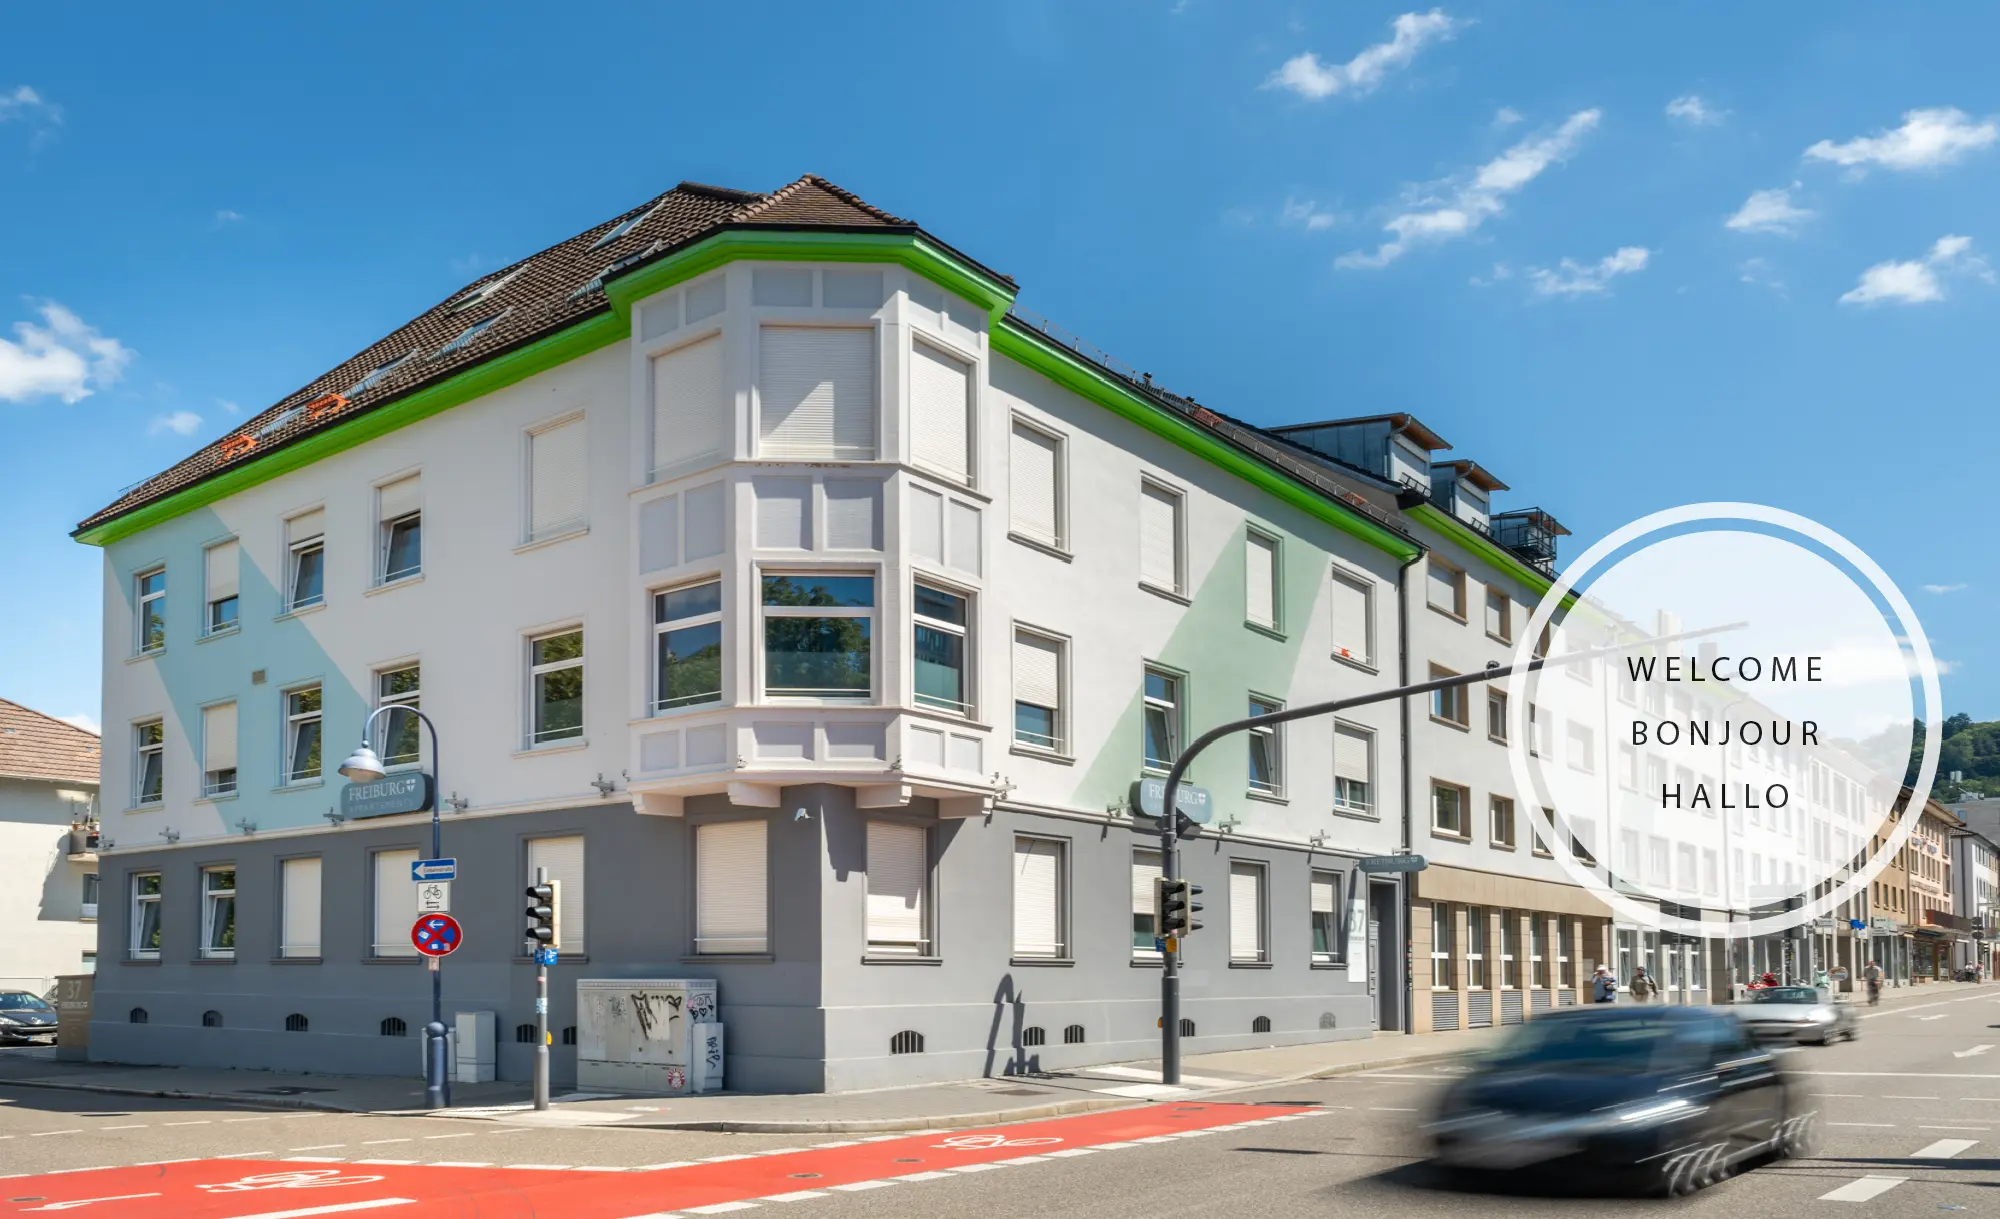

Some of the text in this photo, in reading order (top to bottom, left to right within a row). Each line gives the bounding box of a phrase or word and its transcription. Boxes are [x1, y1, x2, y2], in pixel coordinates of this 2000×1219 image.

[349, 781, 405, 802] FREIBURG
[1149, 783, 1198, 805] FRURG
[66, 980, 82, 999] 37
